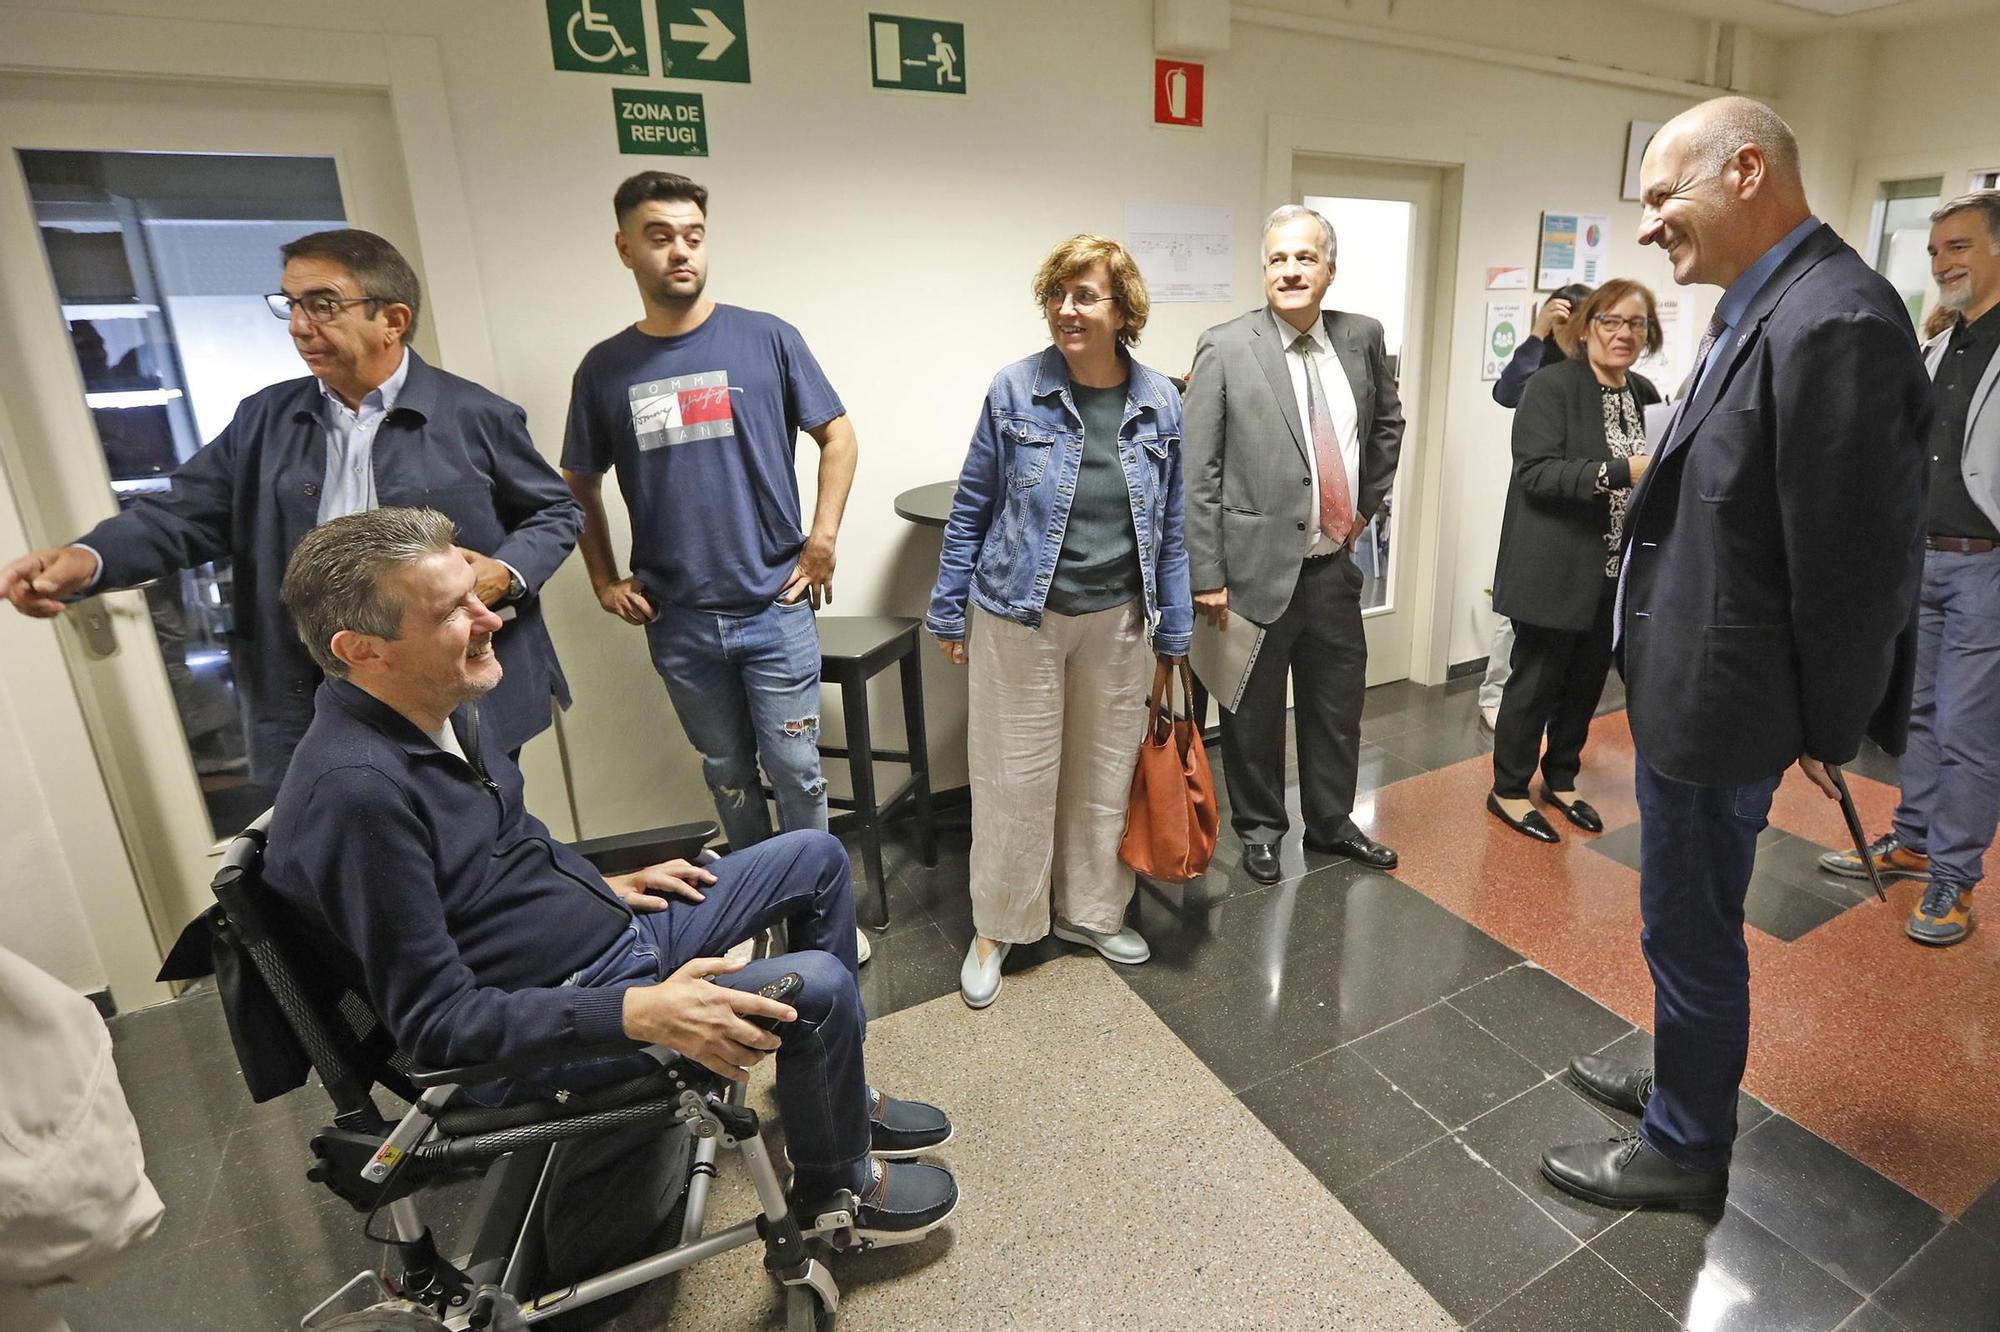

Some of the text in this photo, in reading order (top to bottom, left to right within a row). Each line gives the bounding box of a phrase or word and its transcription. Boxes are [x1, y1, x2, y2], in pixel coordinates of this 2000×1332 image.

[622, 102, 700, 122] ZONA DE
[631, 125, 697, 143] REFUGI
[631, 373, 725, 397] TOMMY
[639, 422, 732, 449] JEANS
